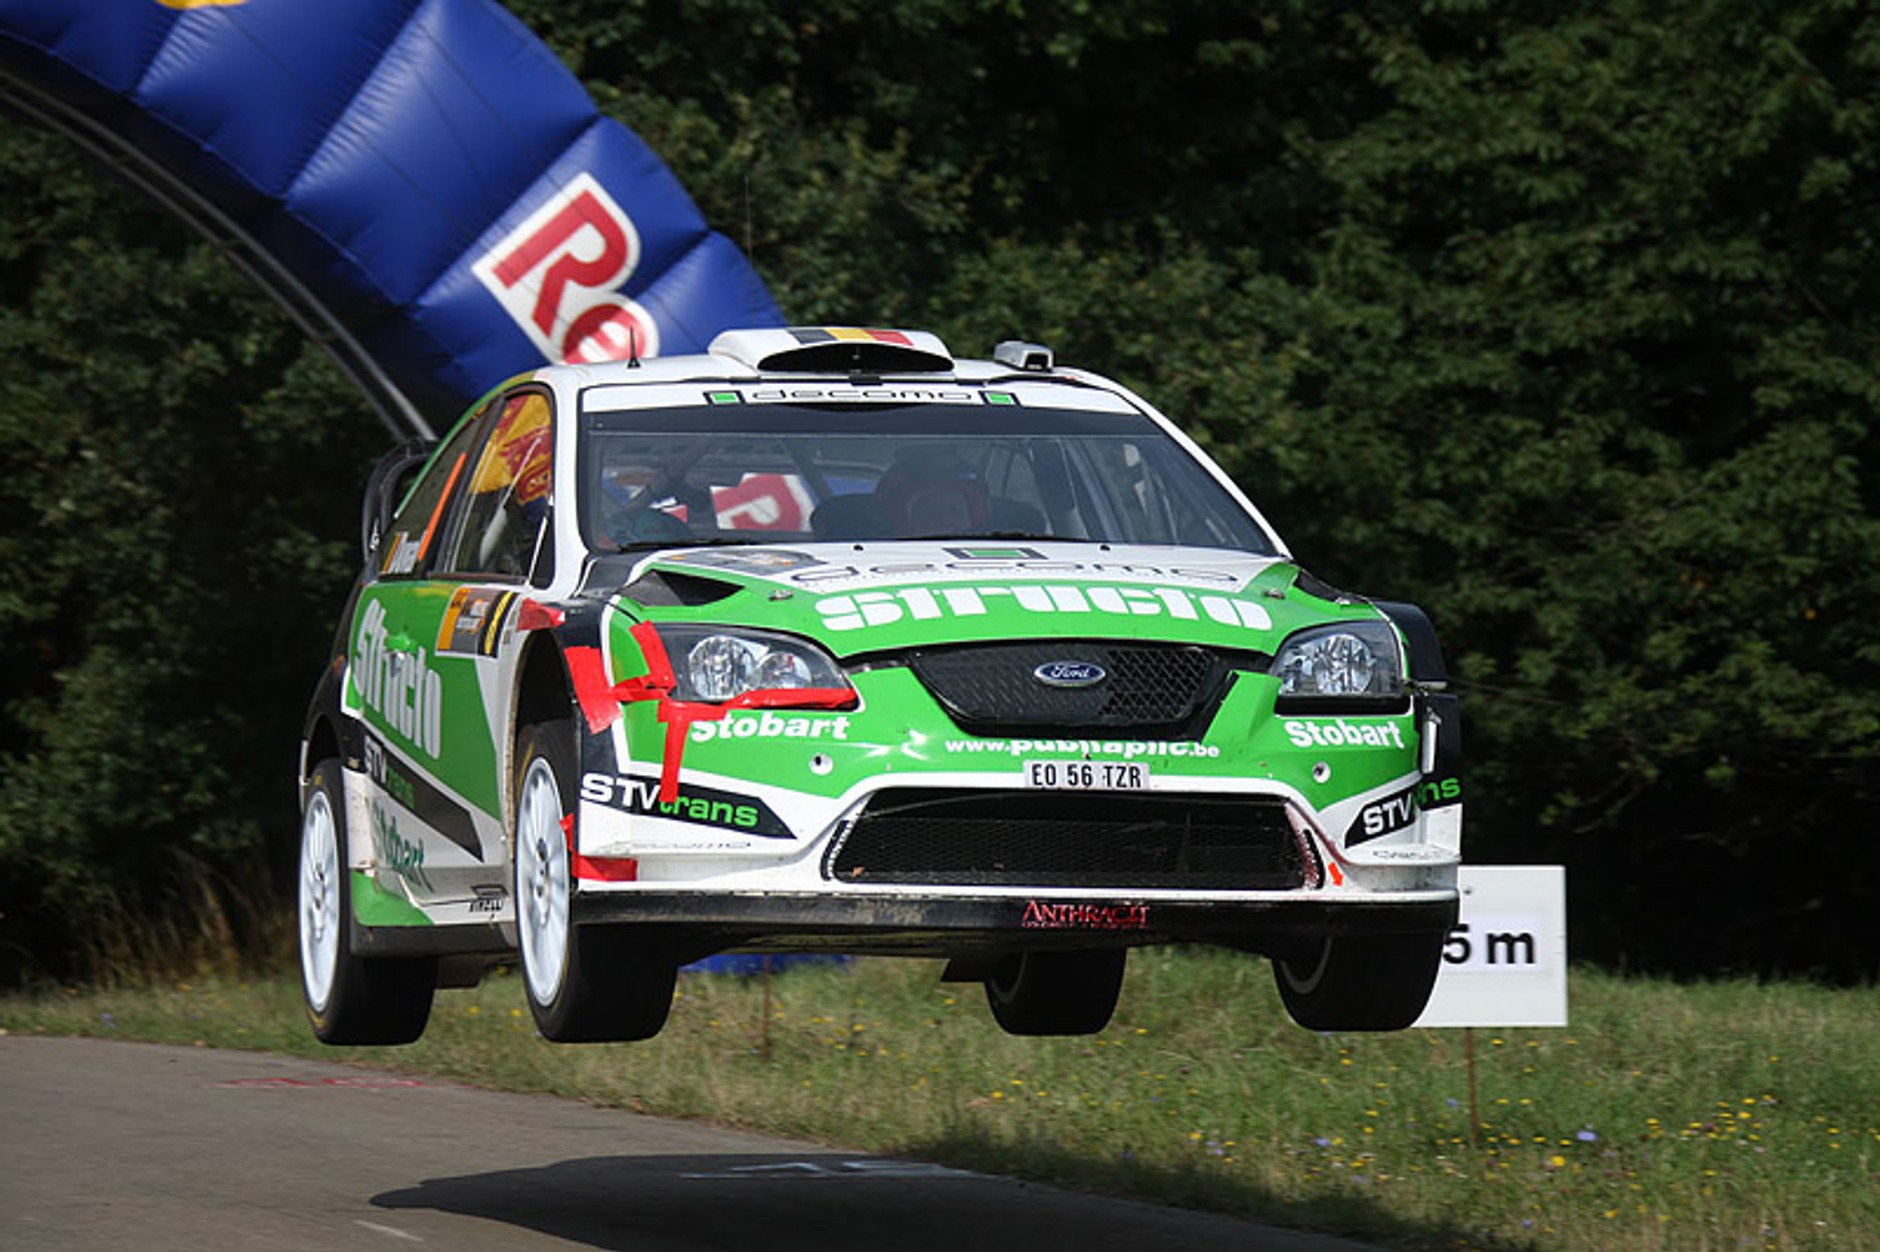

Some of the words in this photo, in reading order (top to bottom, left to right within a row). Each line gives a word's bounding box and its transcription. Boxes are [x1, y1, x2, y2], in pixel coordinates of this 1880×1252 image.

[1050, 663, 1090, 679] Ford
[690, 712, 851, 742] Stobart
[1284, 719, 1405, 749] Stobart
[1066, 764, 1093, 788] 56
[1102, 765, 1142, 789] TZR
[1486, 931, 1536, 965] m
